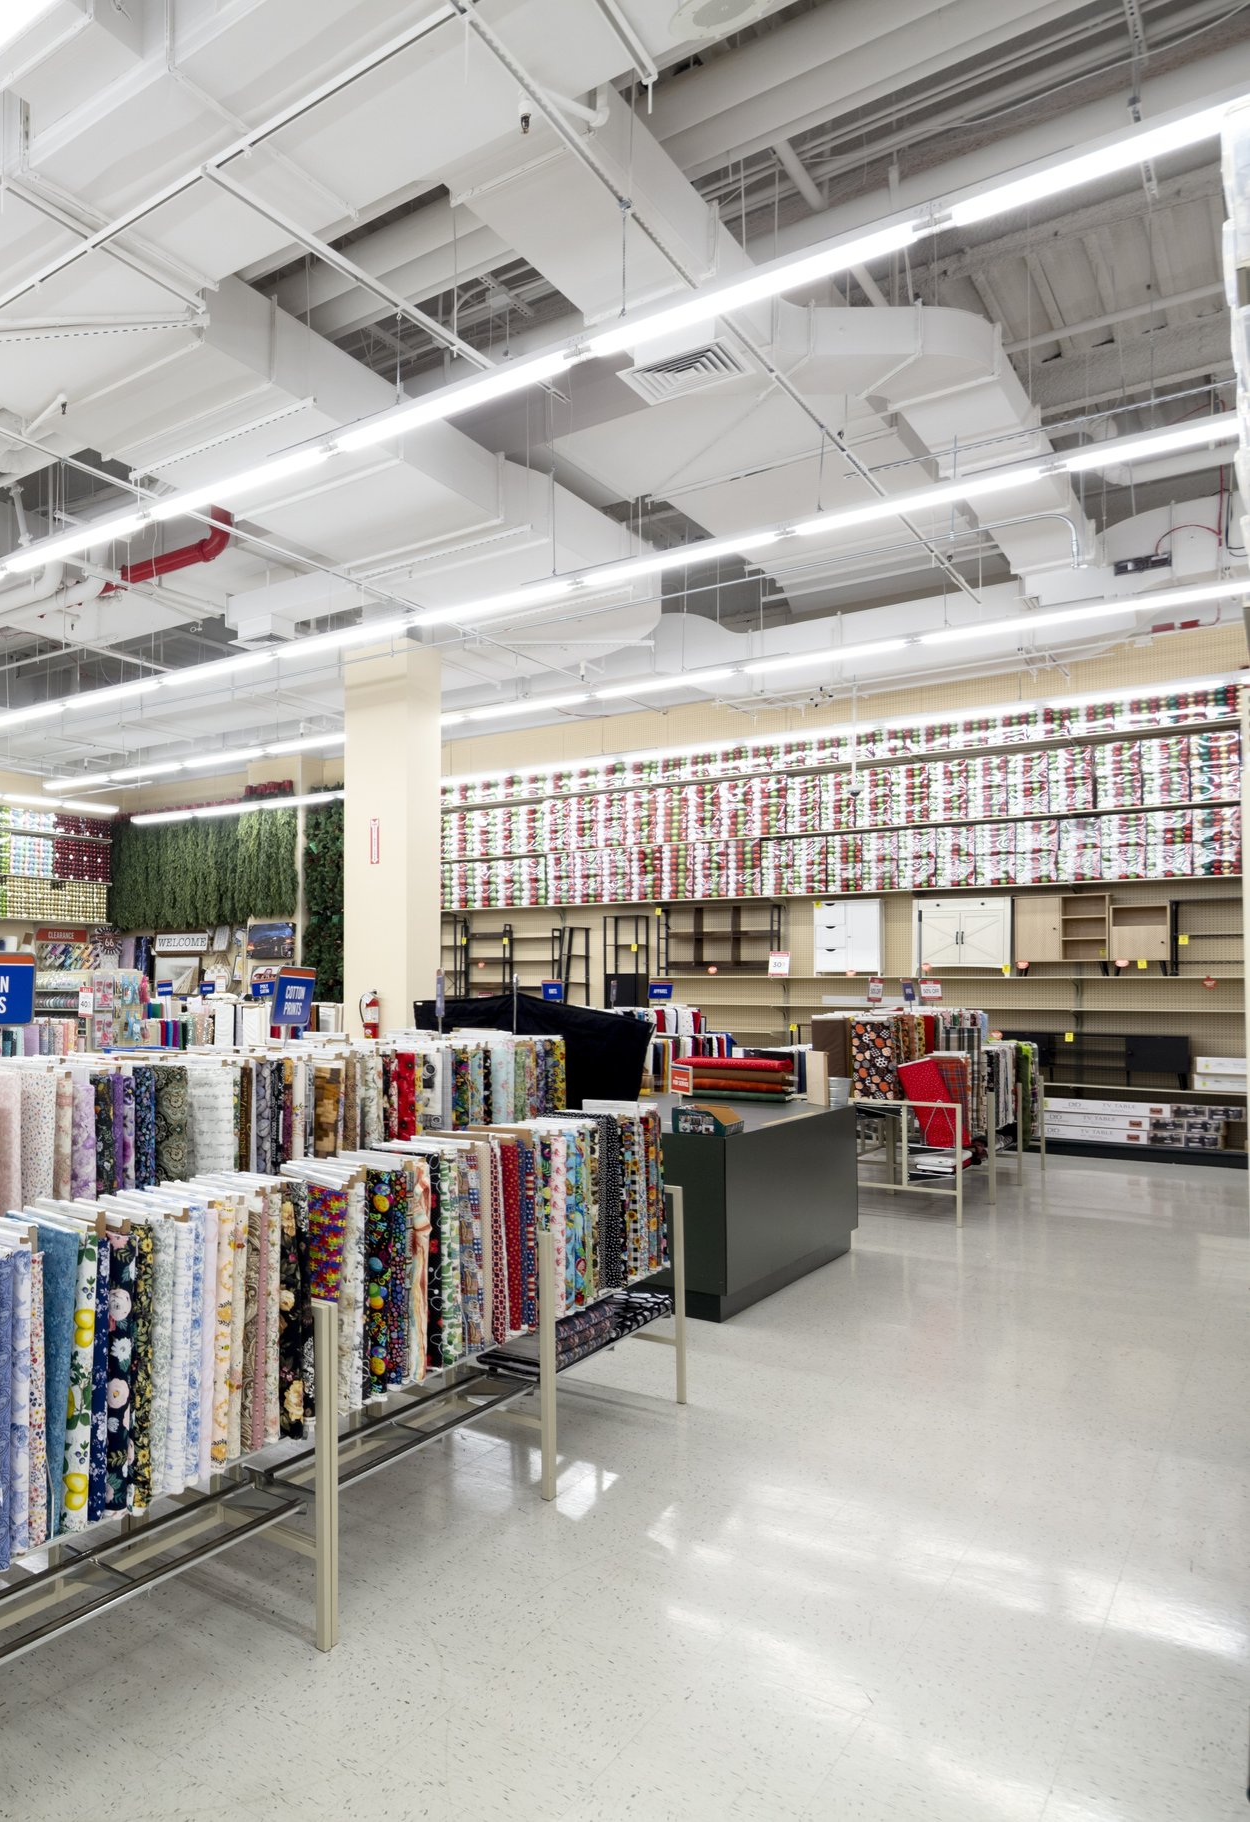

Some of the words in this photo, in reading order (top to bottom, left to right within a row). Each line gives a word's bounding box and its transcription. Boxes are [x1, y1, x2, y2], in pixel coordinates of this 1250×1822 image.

[48, 931, 74, 940] CLEARANCE
[105, 938, 114, 946] 66
[158, 937, 206, 947] WELCOME
[285, 985, 306, 999] COTTON
[283, 1001, 302, 1015] PRINTS
